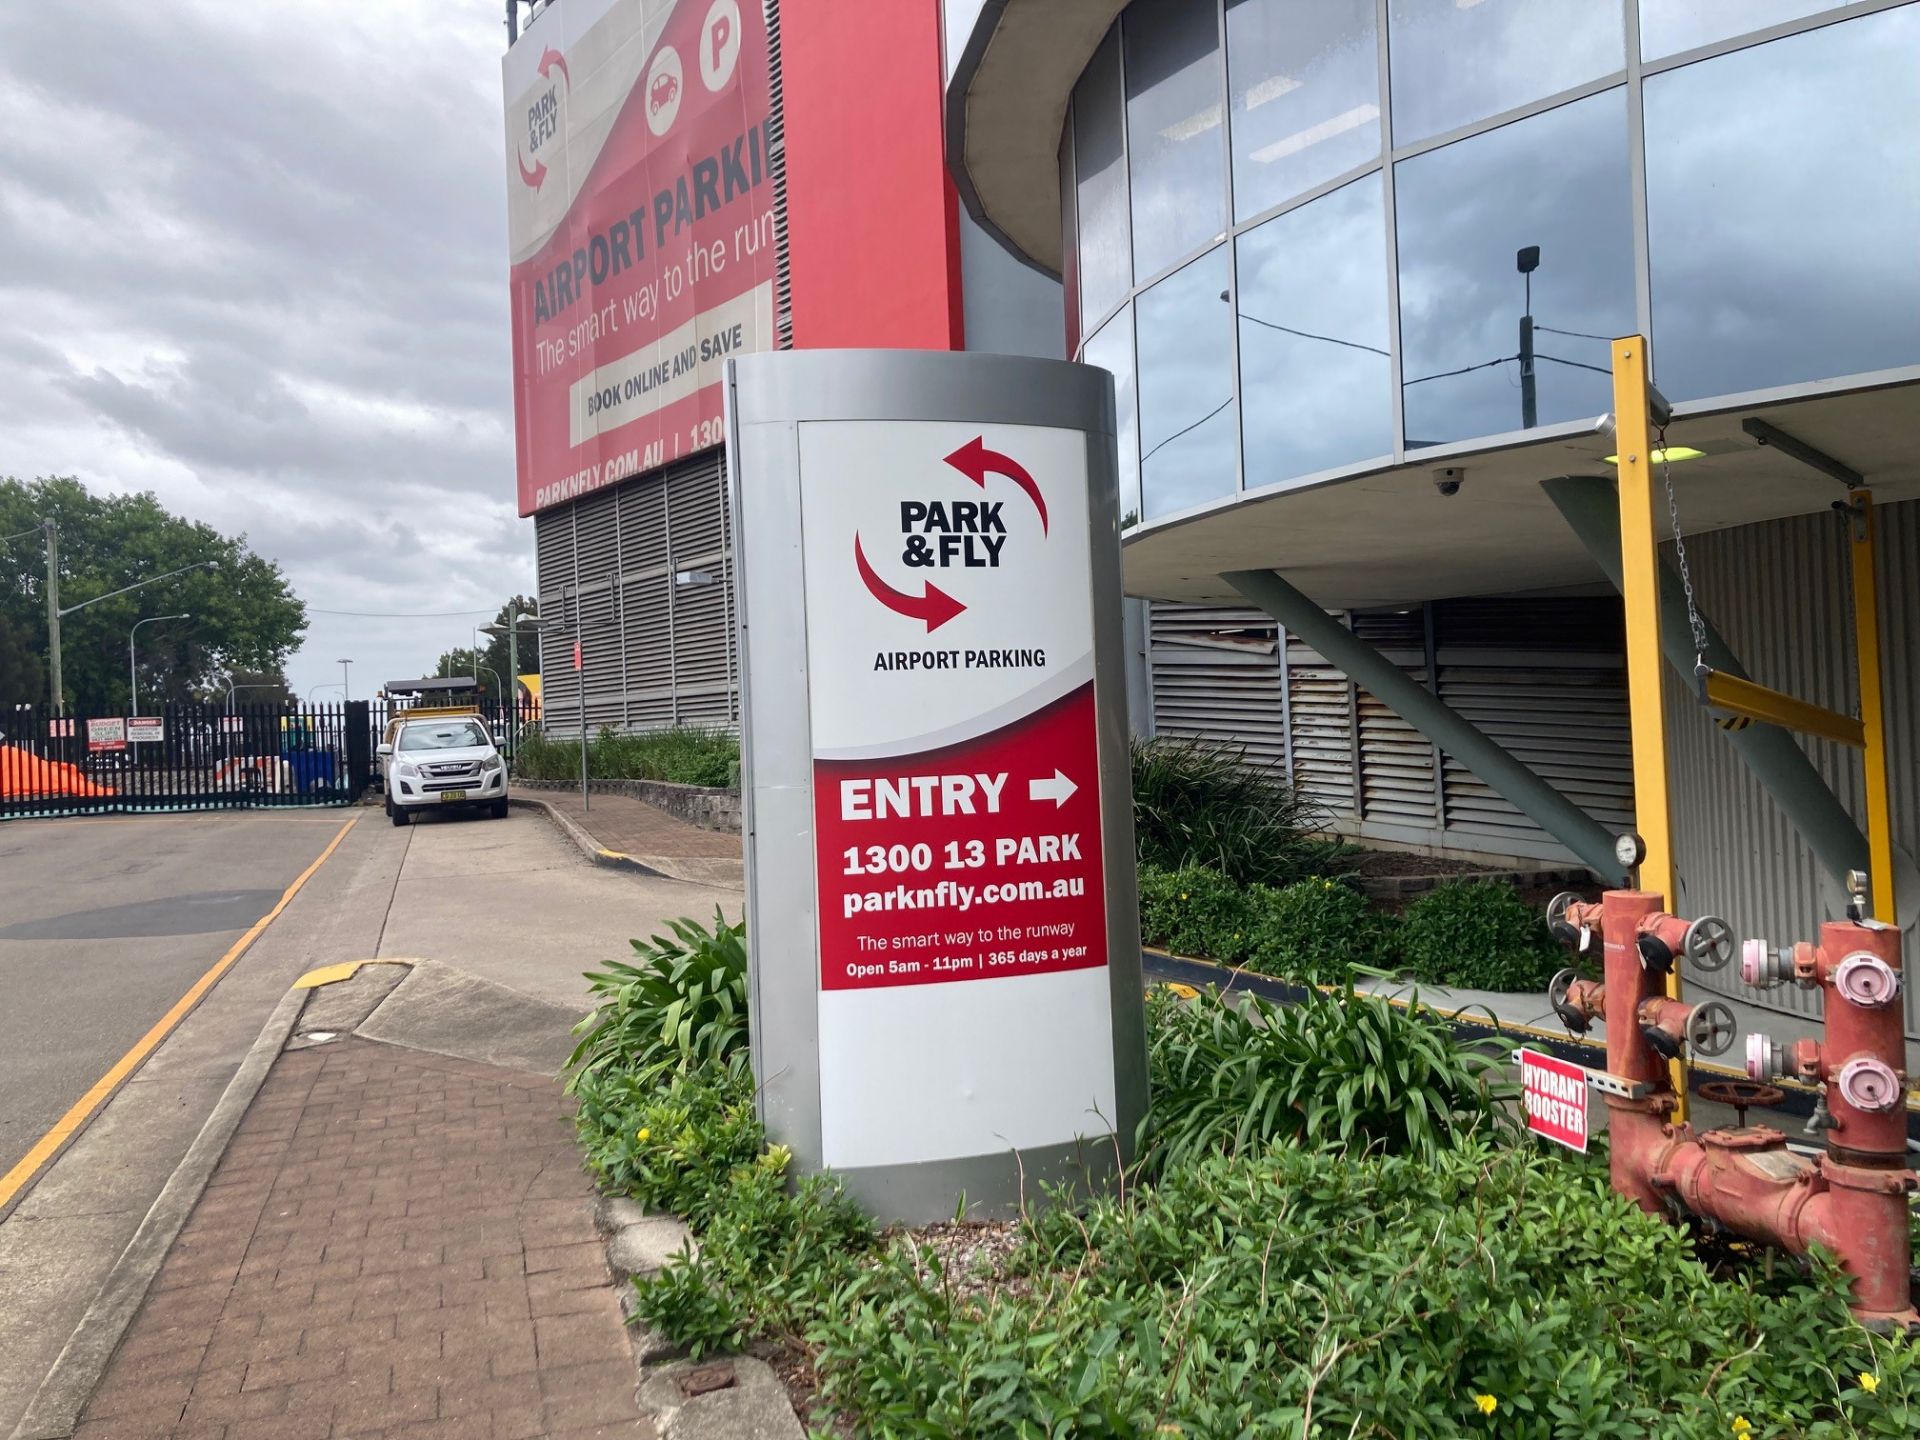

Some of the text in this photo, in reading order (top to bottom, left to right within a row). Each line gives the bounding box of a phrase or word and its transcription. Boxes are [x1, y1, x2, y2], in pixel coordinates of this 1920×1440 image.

[528, 85, 557, 131] PARK
[529, 110, 557, 153] &FLY
[534, 206, 646, 327] AIRPORT
[536, 336, 564, 377] The
[568, 305, 618, 357] smart
[623, 277, 659, 325] way
[664, 265, 682, 302] to
[686, 239, 725, 286] the
[588, 323, 742, 417] BOOK ONLINE AND SAVE
[536, 439, 664, 508] PARKNFLY.COM.AU
[900, 501, 1007, 533] PARK
[902, 535, 1007, 567] &FLY
[873, 649, 1046, 671] AIRPORT PARKING
[840, 772, 1009, 821] ENTRY
[843, 833, 1082, 875] 1300 13 PARK
[843, 877, 1085, 918] parknfly.com.au
[857, 922, 1075, 952] The smart way to the runway
[846, 962, 884, 978] Open
[888, 959, 920, 974] 5am
[932, 955, 973, 972] 11pm
[988, 951, 1016, 966] 365
[1019, 948, 1048, 964] days
[1051, 949, 1059, 960] a
[1062, 945, 1087, 961] year
[1523, 1063, 1584, 1106] HYDRANT
[1524, 1089, 1584, 1135] BOOSTER
